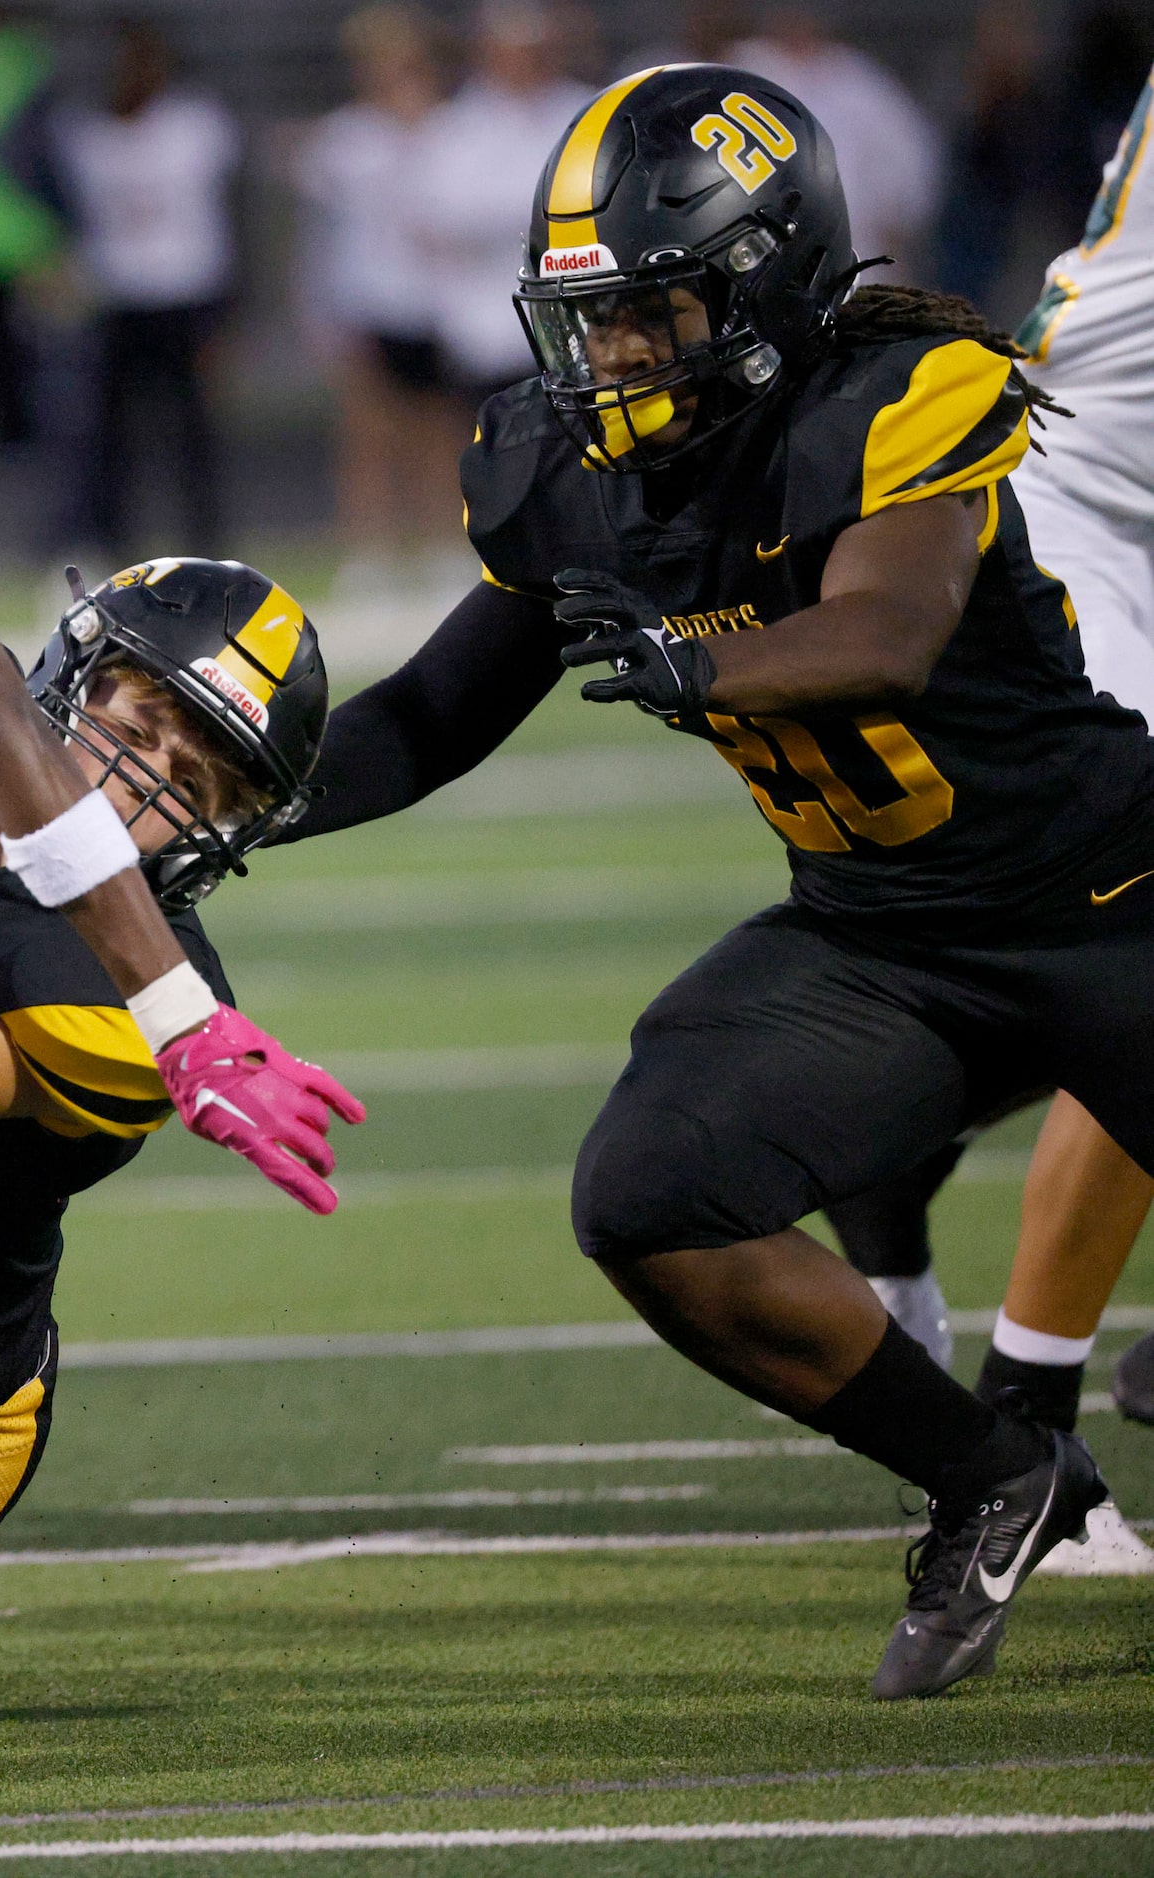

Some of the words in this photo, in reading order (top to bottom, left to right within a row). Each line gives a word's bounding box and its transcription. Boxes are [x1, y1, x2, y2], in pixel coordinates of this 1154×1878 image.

[690, 92, 797, 196] 20
[544, 250, 601, 272] Riddell
[201, 667, 263, 724] Riddell
